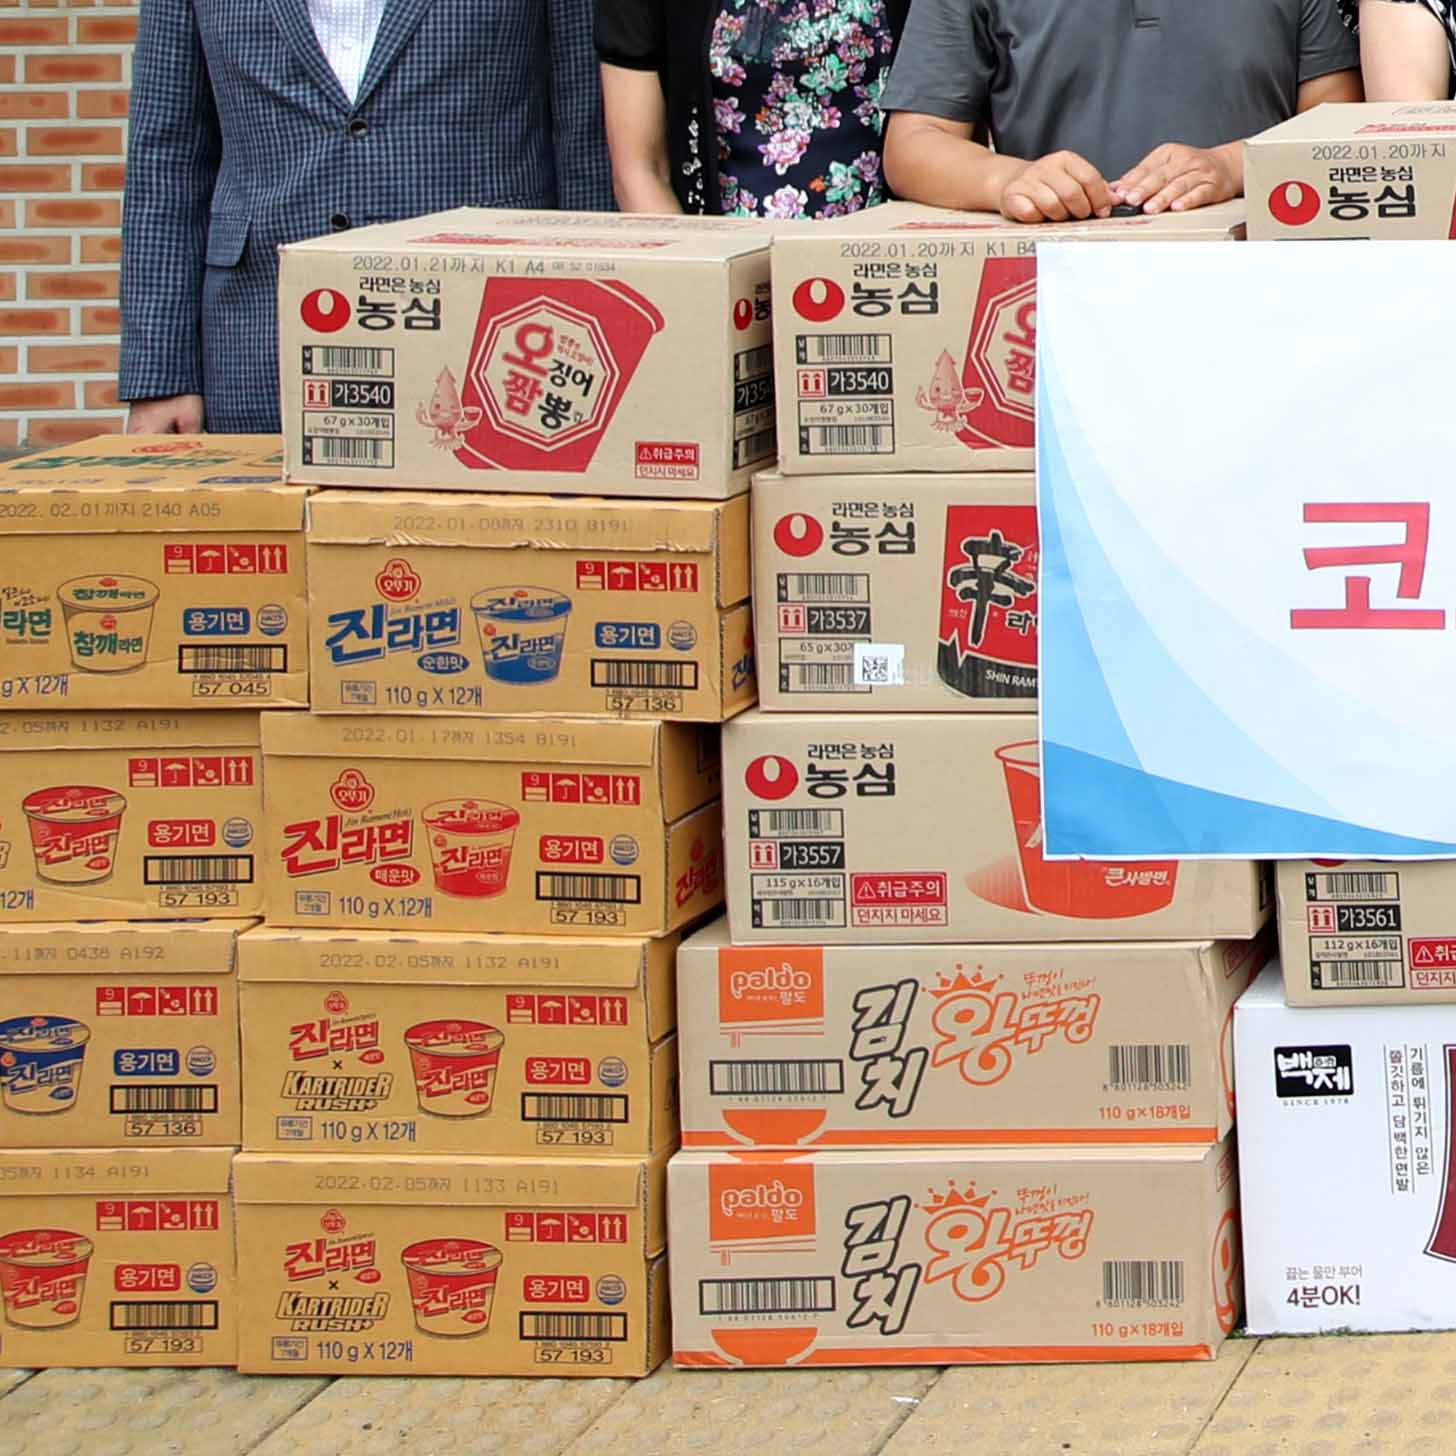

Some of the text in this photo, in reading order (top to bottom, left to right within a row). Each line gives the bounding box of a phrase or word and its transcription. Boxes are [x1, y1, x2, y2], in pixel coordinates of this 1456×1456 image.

[1328, 186, 1416, 220] 농심
[356, 297, 441, 331] 농심
[851, 282, 939, 316] 농심
[335, 383, 392, 406] 가3540
[831, 372, 888, 391] 가3540
[830, 522, 915, 556] 농심
[948, 529, 1035, 648] 辛
[326, 604, 461, 665] 진라면
[811, 610, 866, 630] 가3537
[805, 762, 895, 799] 농심
[281, 815, 413, 877] 진라면
[783, 846, 841, 866] 가3557
[877, 881, 941, 898] 취급주의
[1340, 907, 1397, 928] 가3561
[730, 965, 811, 998] paldo
[288, 1018, 379, 1062] 진라면
[850, 978, 928, 1118] 김치
[281, 1072, 393, 1098] KARTRIDER
[722, 1182, 802, 1214] paldo
[284, 1239, 376, 1282] 진라면
[843, 1195, 1093, 1334] 김치 왕뚜껑
[121, 1268, 176, 1288] 용기면
[529, 1279, 584, 1299] 용기면
[275, 1292, 391, 1319] KARTRIDER
[1287, 1285, 1360, 1308] 4분OK!
